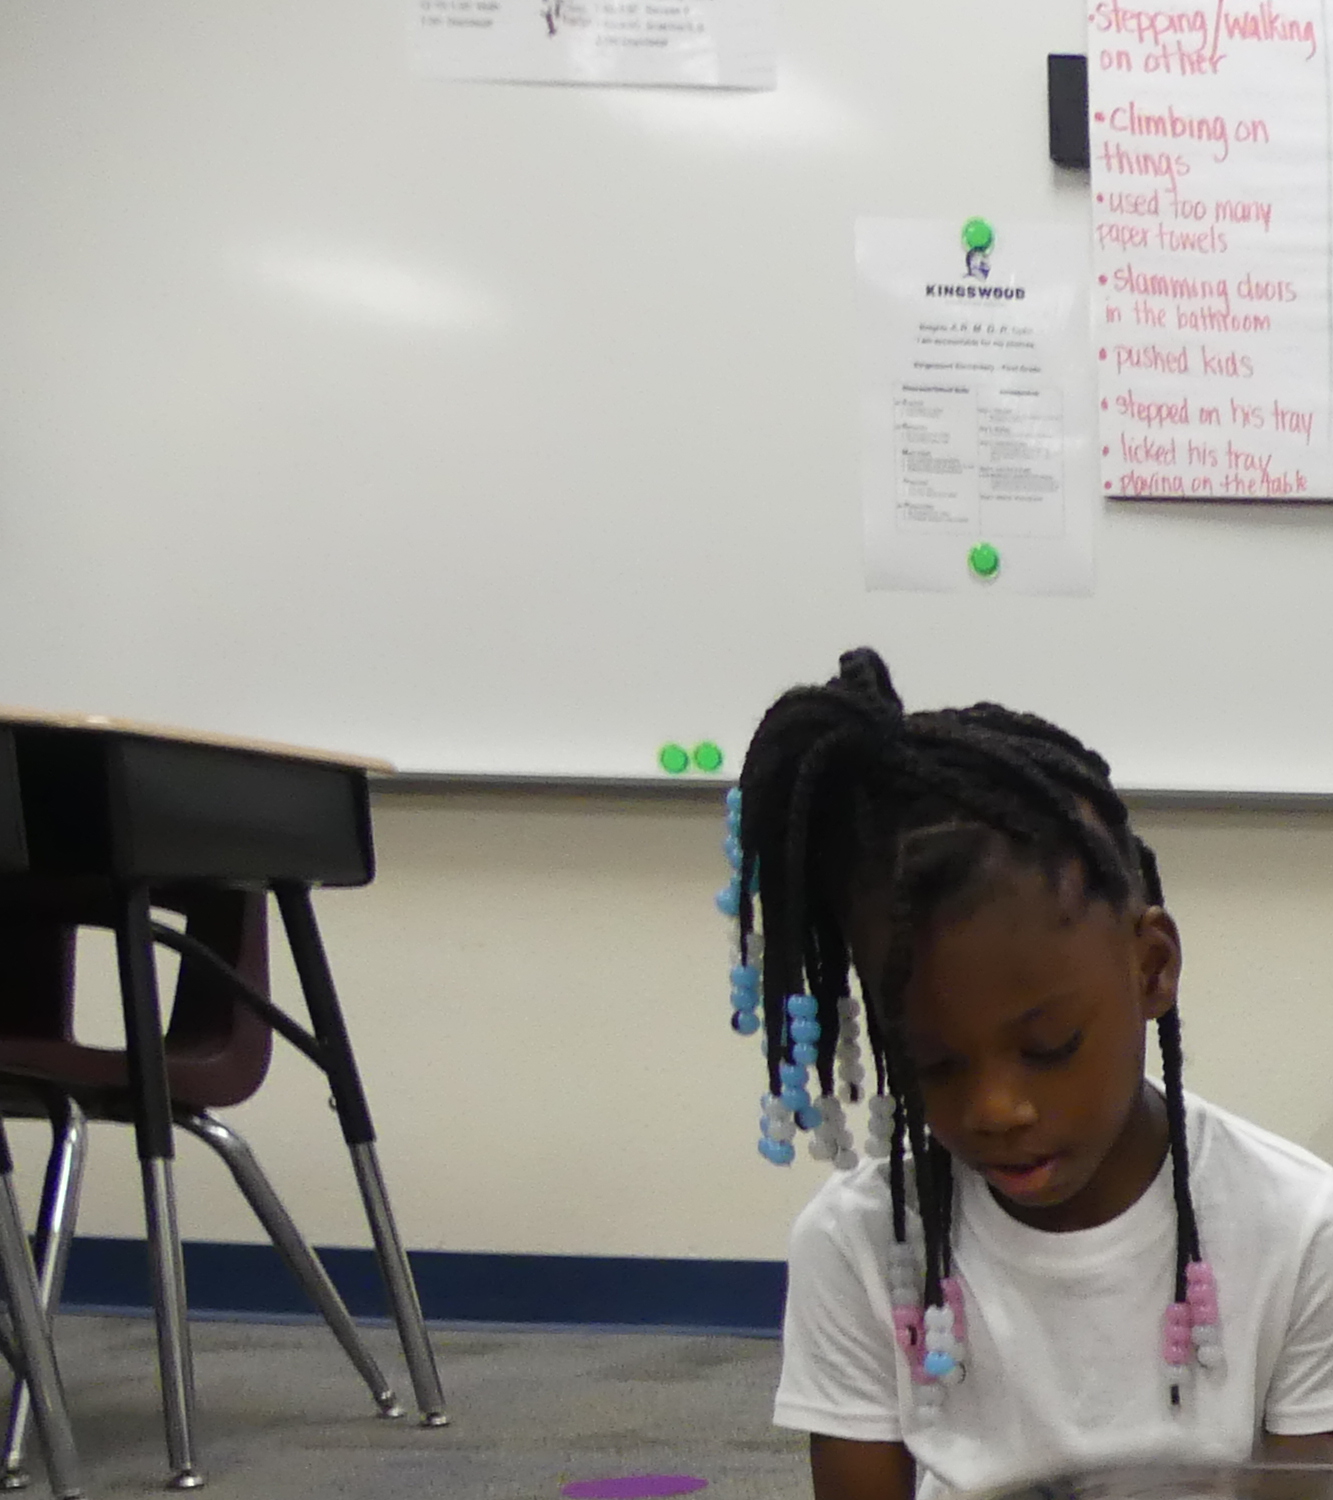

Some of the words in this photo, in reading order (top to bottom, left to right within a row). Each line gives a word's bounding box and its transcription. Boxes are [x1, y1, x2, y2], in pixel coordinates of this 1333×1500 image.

[1100, 49, 1132, 72] on
[1144, 40, 1227, 76] other
[1235, 119, 1269, 143] on
[1097, 140, 1191, 190] things
[1110, 189, 1159, 216] used
[1167, 192, 1207, 220] too
[1215, 200, 1272, 233] many
[1097, 223, 1148, 251] paper
[1157, 222, 1228, 254] towels
[925, 284, 1026, 300] KINGSWOOD
[1237, 271, 1298, 302] doors
[1106, 298, 1121, 323] in
[1134, 300, 1167, 327] the
[1177, 303, 1271, 332] bathroom
[1113, 345, 1188, 374] pushed
[1202, 345, 1255, 378] kids
[1200, 405, 1221, 426] on
[1230, 397, 1265, 428] his
[1274, 399, 1313, 446] tray
[1121, 431, 1176, 466] licked
[1188, 438, 1219, 468] his
[1228, 439, 1272, 474] tray
[1191, 474, 1214, 496] on
[1220, 472, 1256, 494] the
